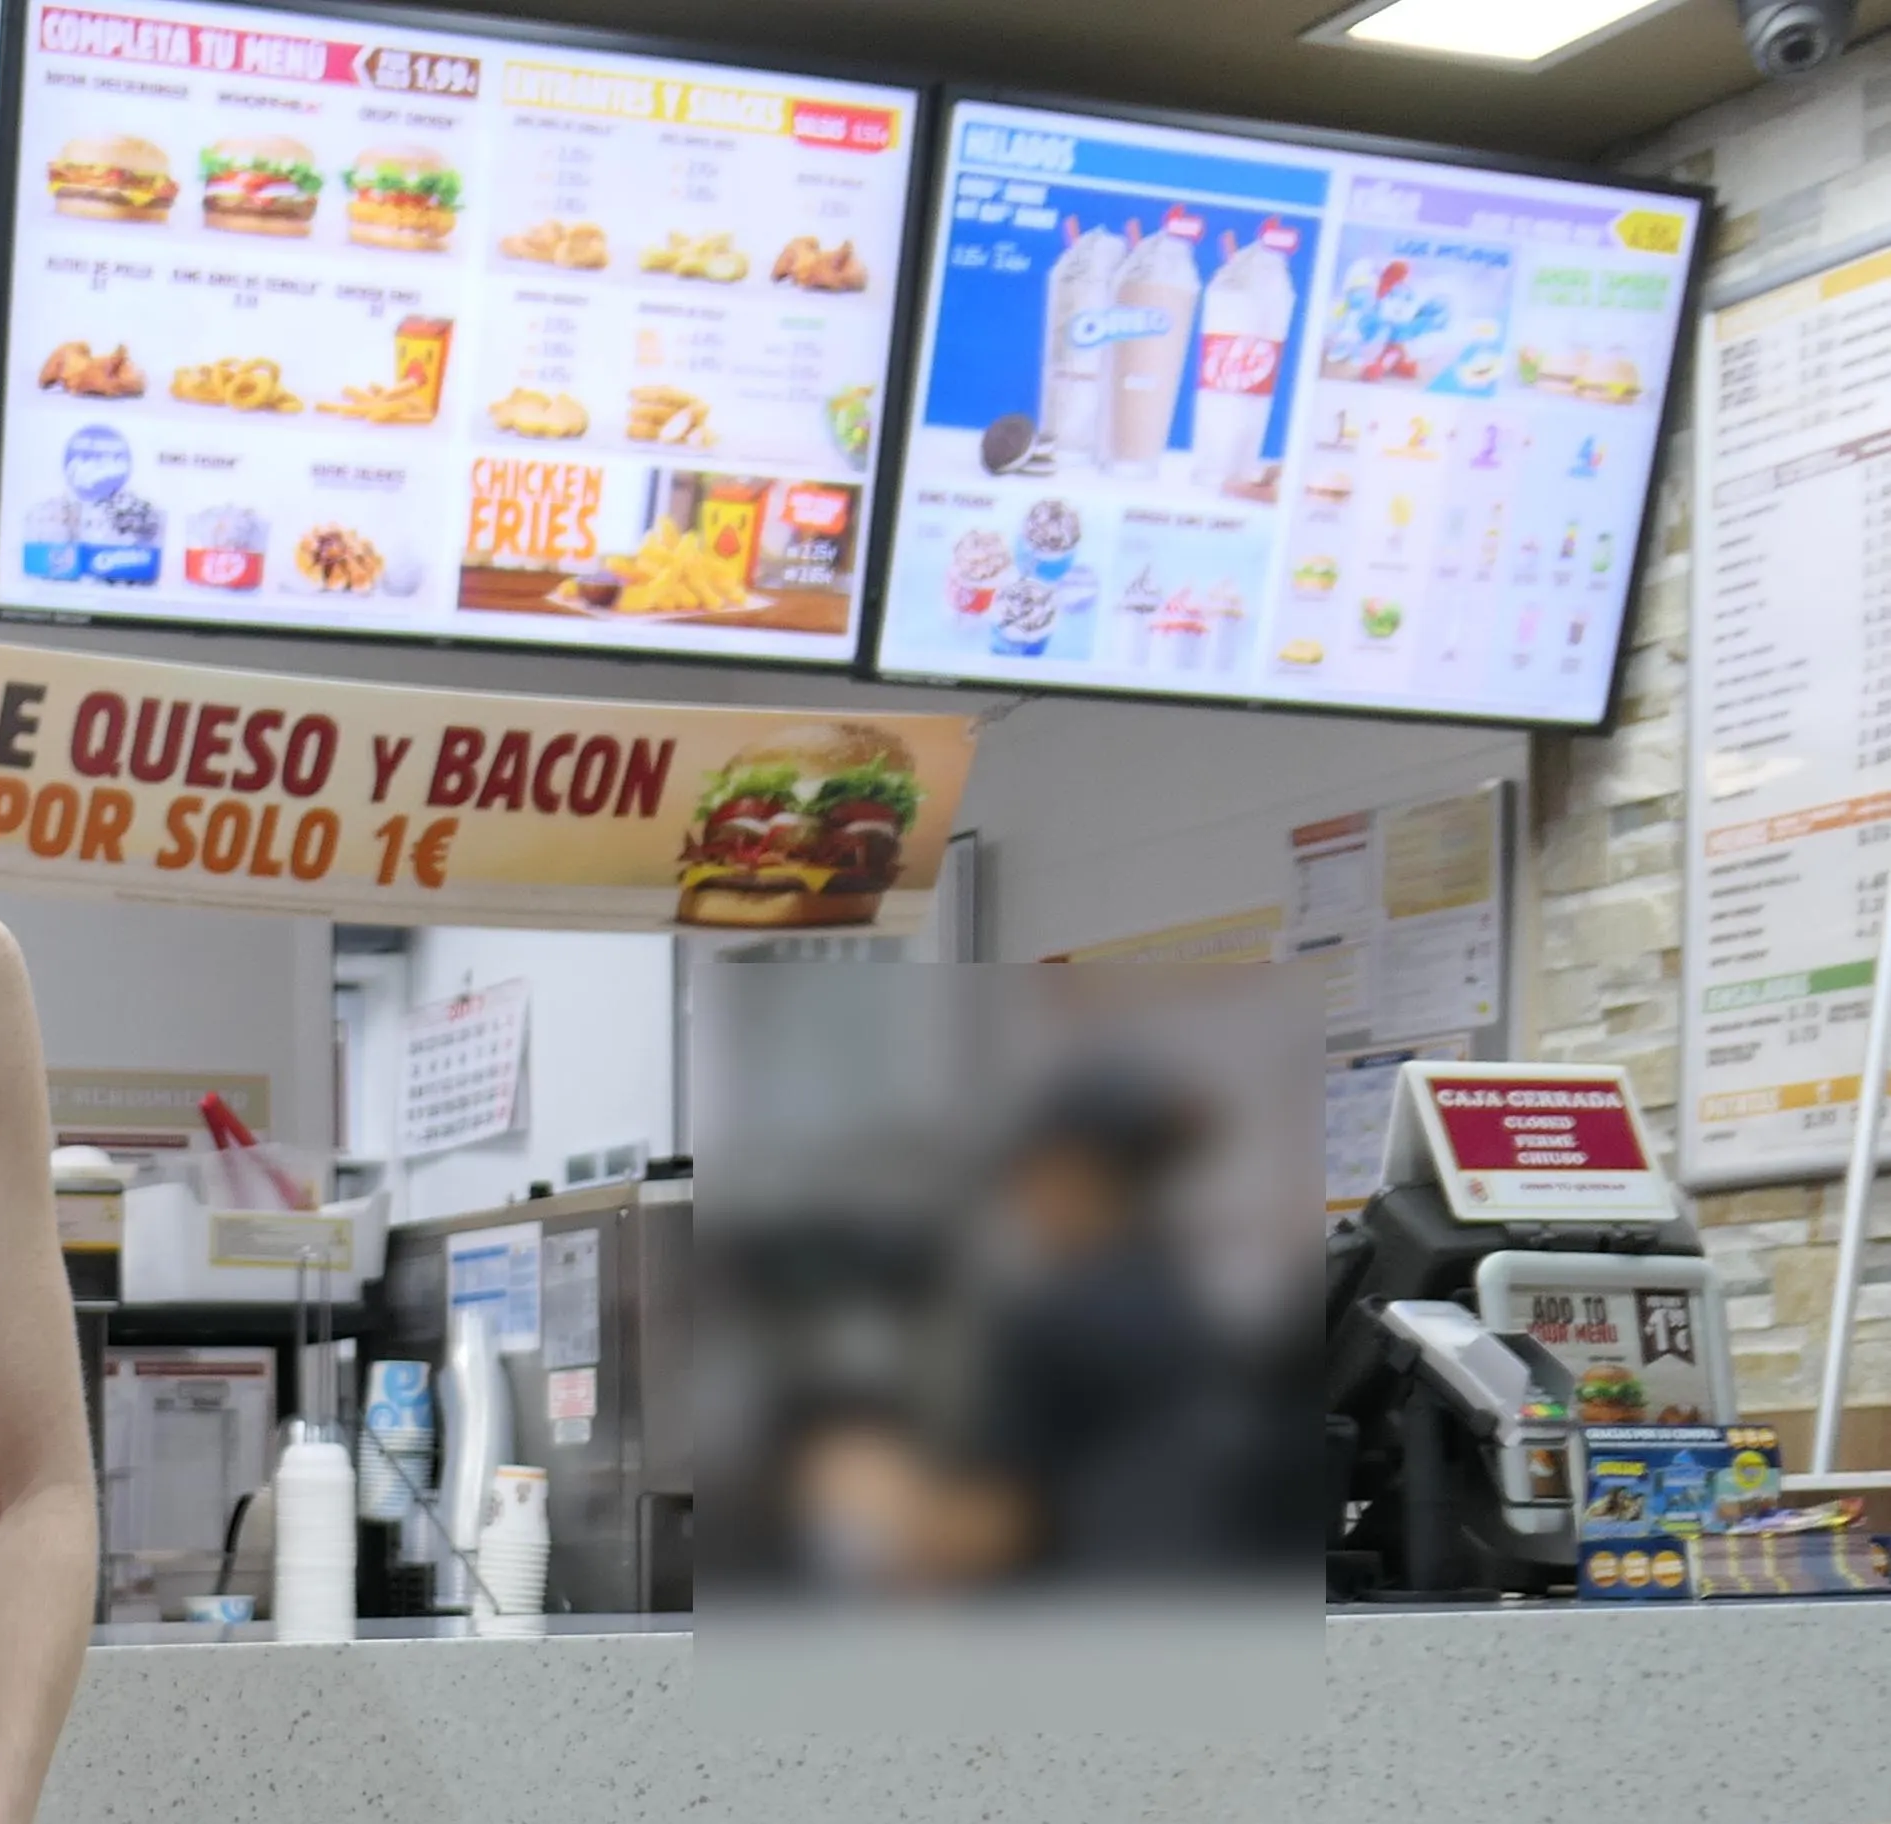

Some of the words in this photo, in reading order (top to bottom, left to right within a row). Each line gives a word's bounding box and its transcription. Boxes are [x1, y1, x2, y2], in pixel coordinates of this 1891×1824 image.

[42, 10, 190, 63] COMPLETA
[200, 29, 237, 69] TU
[472, 457, 604, 504] CHICKEN
[466, 498, 598, 561] FRIES
[70, 691, 339, 798] QUESO
[427, 726, 676, 817] BACON
[155, 795, 341, 881] SOLO
[373, 815, 460, 889] 1€
[1437, 1089, 1504, 1107] CAJA
[1506, 1090, 1625, 1109] CERRADA
[1504, 1116, 1576, 1130] CLOSED
[1517, 1151, 1588, 1165] CHIUSO
[1533, 1295, 1574, 1323] ADD
[1581, 1295, 1607, 1325] TO
[1575, 1323, 1619, 1344] MENU
